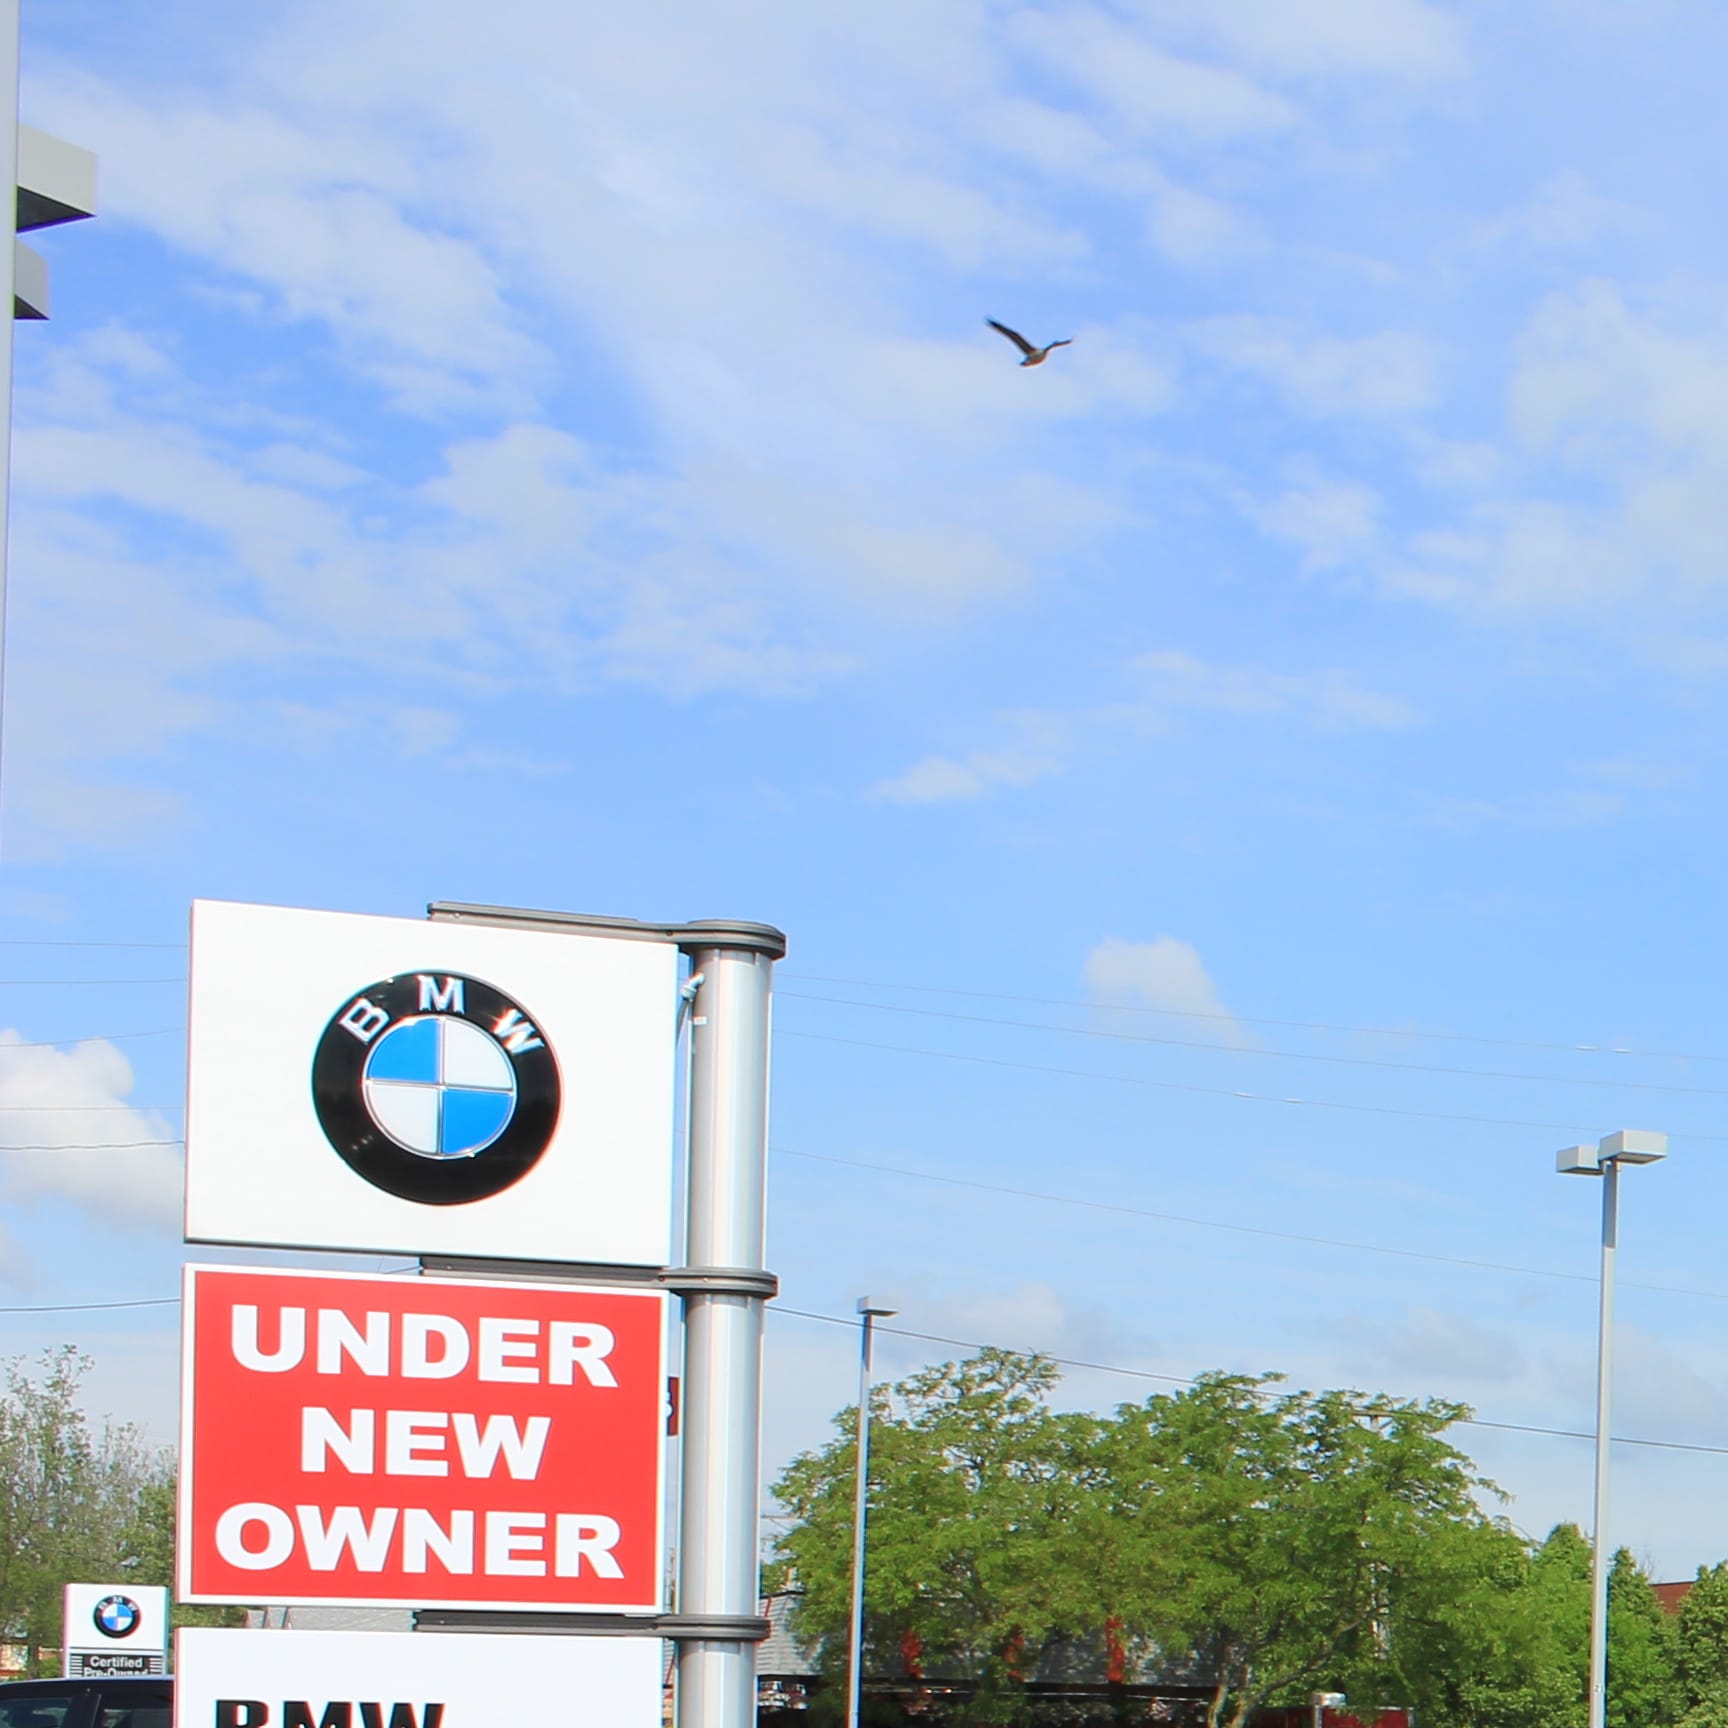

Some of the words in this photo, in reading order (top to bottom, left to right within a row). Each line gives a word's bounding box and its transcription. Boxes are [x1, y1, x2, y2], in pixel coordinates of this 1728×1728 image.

[338, 974, 545, 1057] BMW
[231, 1303, 619, 1388] UNDER
[300, 1408, 552, 1480] NEW
[214, 1502, 626, 1580] OWNER
[90, 1656, 143, 1668] Certified
